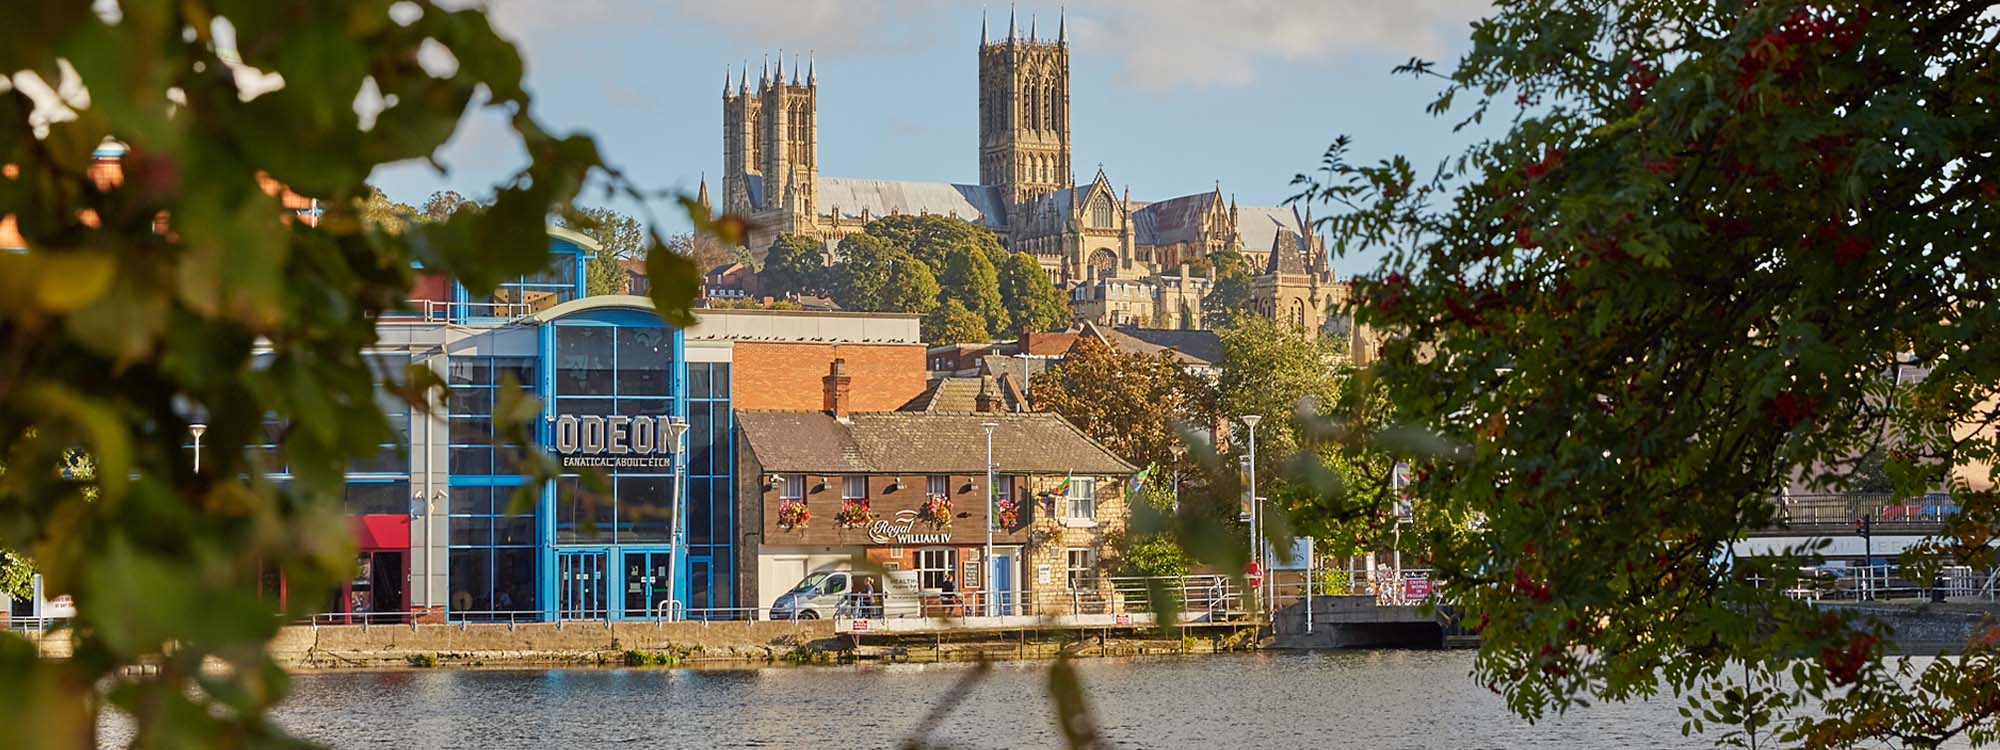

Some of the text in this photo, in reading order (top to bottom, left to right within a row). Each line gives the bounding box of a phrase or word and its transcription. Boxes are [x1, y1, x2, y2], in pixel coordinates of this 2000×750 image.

[556, 415, 685, 454] ODEON
[563, 457, 670, 467] FANATICAL ABOUT FILM
[872, 520, 914, 537] Royal
[897, 534, 951, 543] WILLIAM IV
